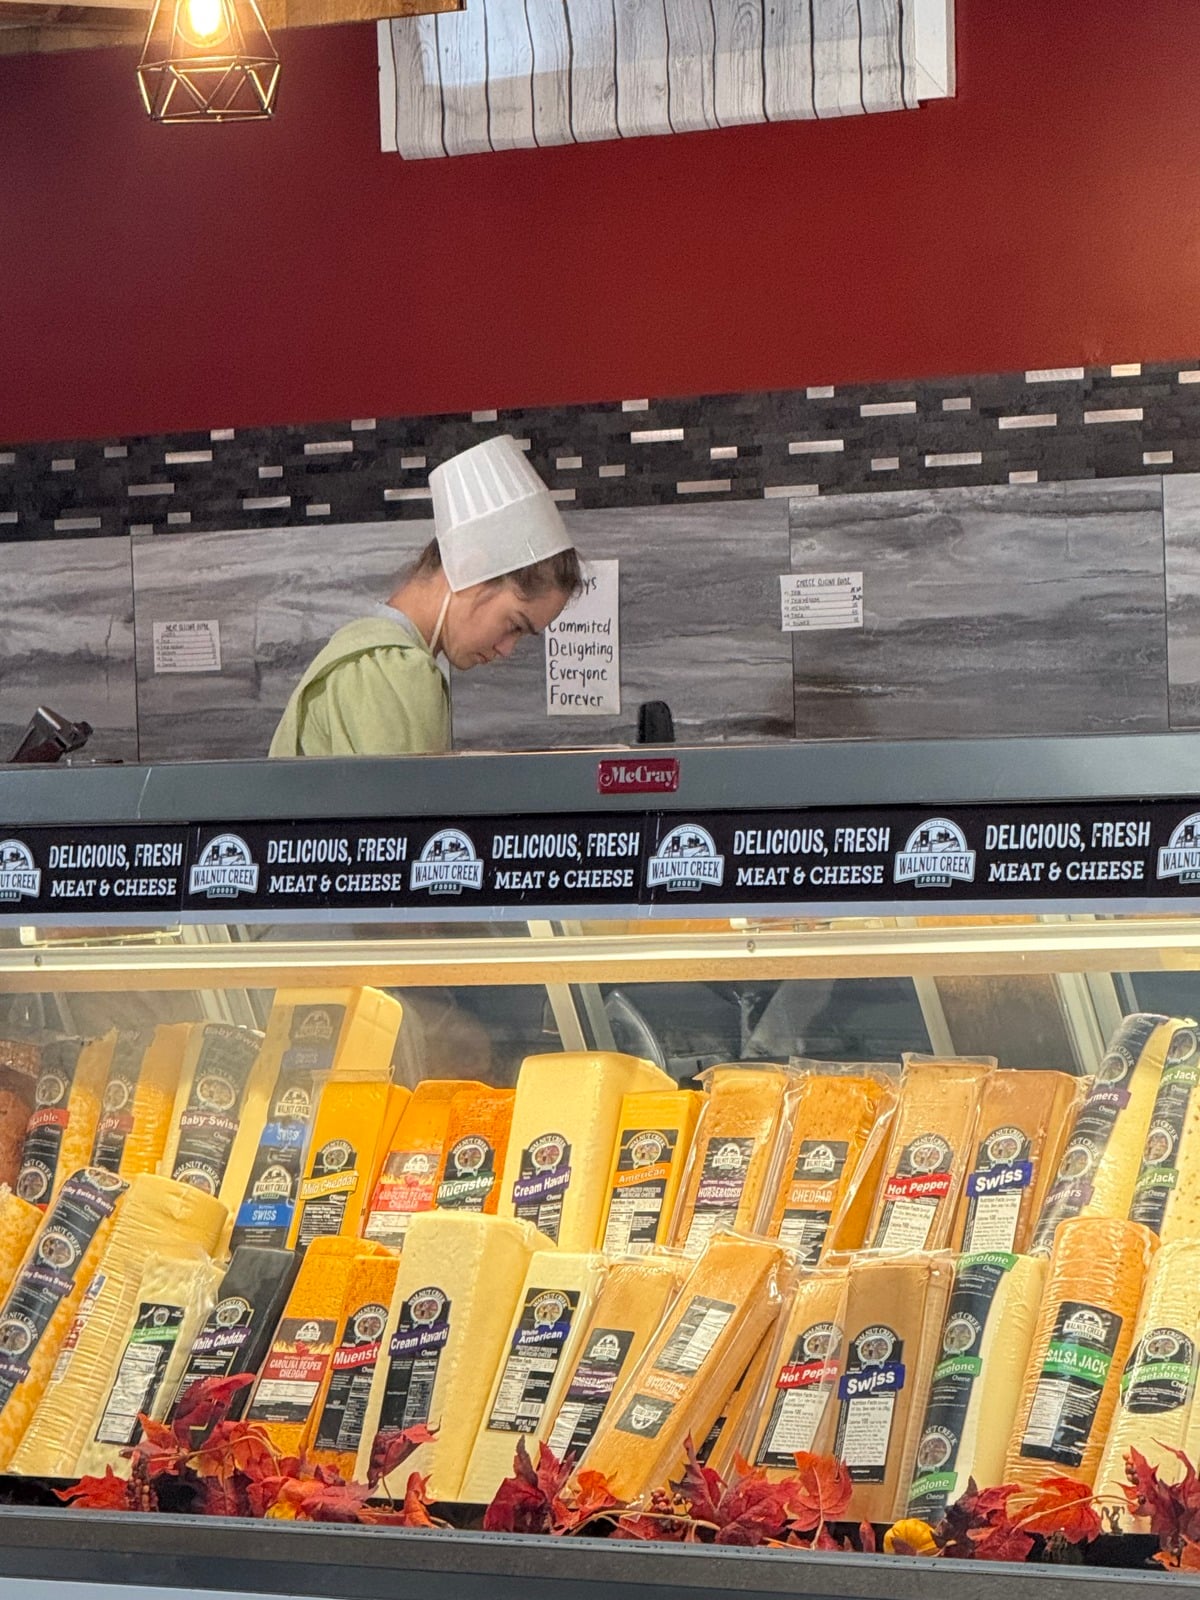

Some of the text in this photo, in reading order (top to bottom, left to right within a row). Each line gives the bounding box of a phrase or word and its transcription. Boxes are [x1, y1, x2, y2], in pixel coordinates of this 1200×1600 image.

[549, 618, 611, 635] Commited
[549, 638, 613, 663] Delighting
[549, 660, 608, 688] Everyone
[550, 685, 604, 706] Forever
[600, 766, 676, 786] McCray
[492, 832, 640, 861] DELICIOUS, FRESH
[733, 828, 890, 857] DELICIOUS, FRESH
[985, 822, 1150, 852] DELICIOUS, FRESH
[49, 843, 183, 870] DELICIOUS, FRESH
[267, 838, 407, 866] DELICIOUS, FRESH
[415, 865, 479, 882] WALNUT CREEK
[652, 861, 720, 879] WALNUT CREEK
[736, 865, 884, 885] MEAT & CHEESE
[900, 856, 971, 875] WALNUT CREEK
[988, 861, 1144, 882] MEAT & CHEESE
[12, 873, 38, 890] CREEK
[50, 878, 177, 897] MEAT & CHEESE
[193, 868, 254, 887] WALNUT CREEK
[269, 874, 402, 894] MEAT & CHEESE
[494, 869, 634, 889] MEAT & CHEESE
[1174, 1070, 1198, 1081] Jack
[181, 1115, 240, 1131] Baby Swiss
[514, 1171, 570, 1197] Cream Havarti
[618, 1169, 666, 1184] American
[974, 1169, 1023, 1192] Swiss
[1151, 1172, 1175, 1183] Jack
[437, 1175, 494, 1199] Muenster
[887, 1180, 949, 1196] Hot Pepper
[252, 1209, 277, 1221] SWISS
[213, 1332, 246, 1348] Cheddar
[391, 1328, 448, 1350] Cream Havarti
[519, 1331, 562, 1345] American
[333, 1347, 378, 1365] Muenst
[1046, 1349, 1109, 1375] SALSA JACK
[780, 1371, 799, 1383] Hot
[846, 1370, 895, 1395] Swiss
